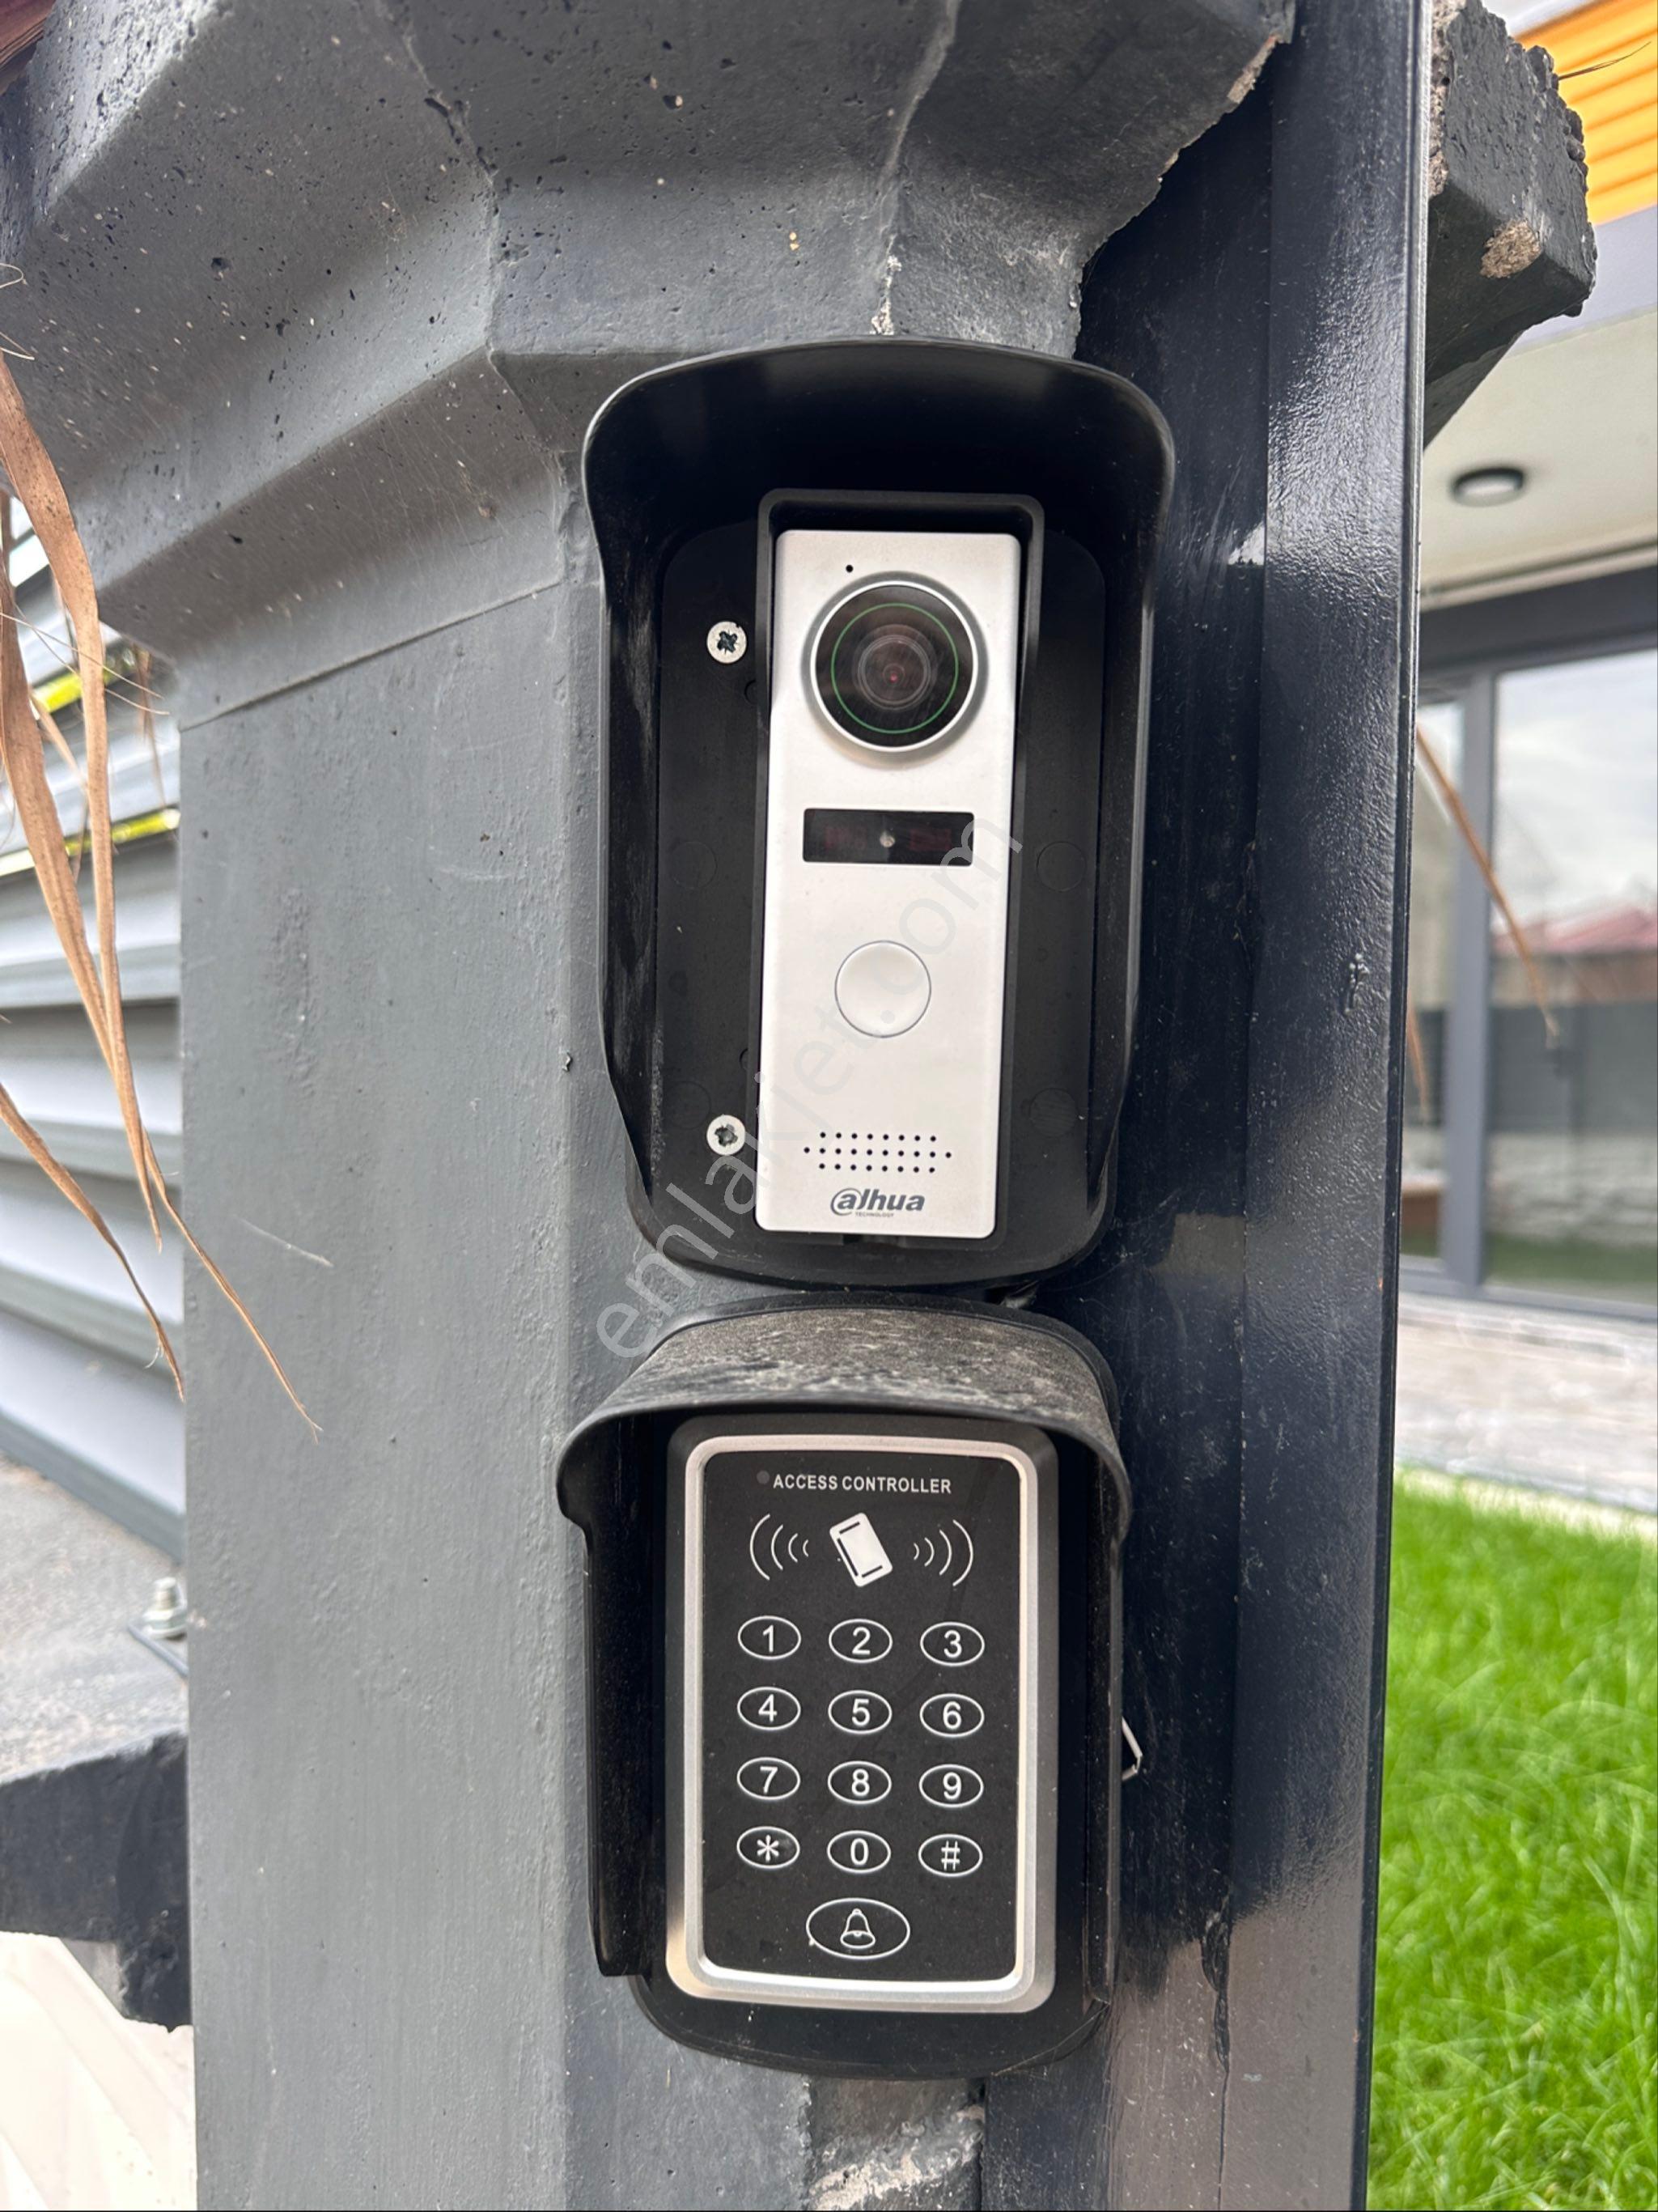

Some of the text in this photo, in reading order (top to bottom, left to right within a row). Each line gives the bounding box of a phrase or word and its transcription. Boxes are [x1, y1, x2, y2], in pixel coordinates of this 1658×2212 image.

[773, 1474, 952, 1494] ACCESS CONTROLLER
[762, 1624, 963, 1659] 1 2 3
[757, 1693, 962, 1731] 4 5 6
[759, 1765, 962, 1802] 7 8 9
[850, 1837, 870, 1866] 0
[940, 1840, 961, 1871] #
